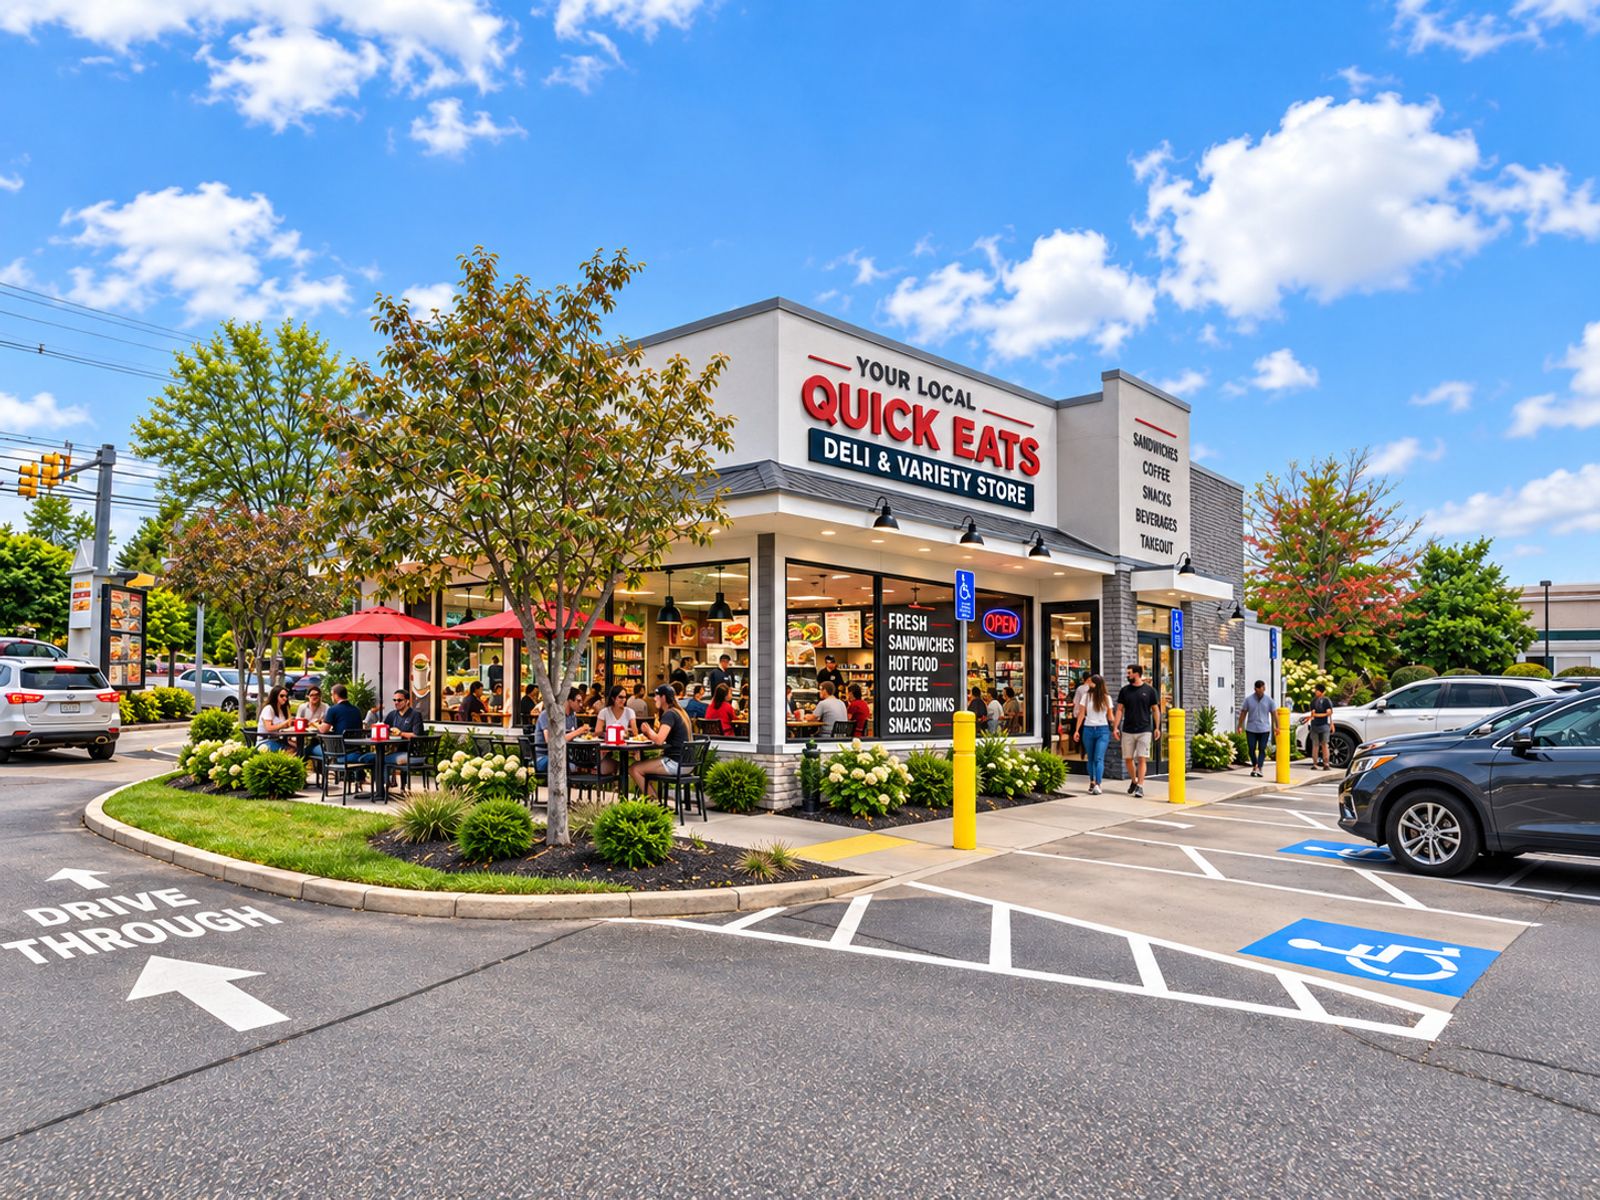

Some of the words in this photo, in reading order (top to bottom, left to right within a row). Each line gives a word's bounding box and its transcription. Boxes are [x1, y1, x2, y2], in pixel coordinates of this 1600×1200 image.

[856, 356, 910, 391] YOUR
[917, 376, 976, 411] LOCAL
[801, 375, 941, 451] QUICK
[953, 415, 1041, 477] EATS
[1133, 432, 1178, 462] SANDWICHES
[824, 437, 870, 468] DELI
[877, 451, 891, 473] &
[897, 456, 972, 491] VARIETY
[976, 476, 1026, 504] STORE
[1142, 460, 1171, 483] COFFEE
[1142, 485, 1172, 507] SNACKS
[1136, 508, 1178, 533] BEVERAGES
[1140, 534, 1174, 555] TAKEOUT
[888, 612, 928, 632] FRESH
[985, 614, 1018, 634] OPEN
[888, 634, 955, 653] SANDWICHES
[888, 655, 910, 671] HOT
[911, 656, 938, 672] FOOD
[888, 675, 929, 692] COFFEE
[888, 696, 916, 712] COLD
[918, 697, 955, 712] DRINKS
[888, 717, 932, 733] SNACKS
[22, 887, 201, 927] DRIVE
[0, 905, 284, 965] THROUGH
